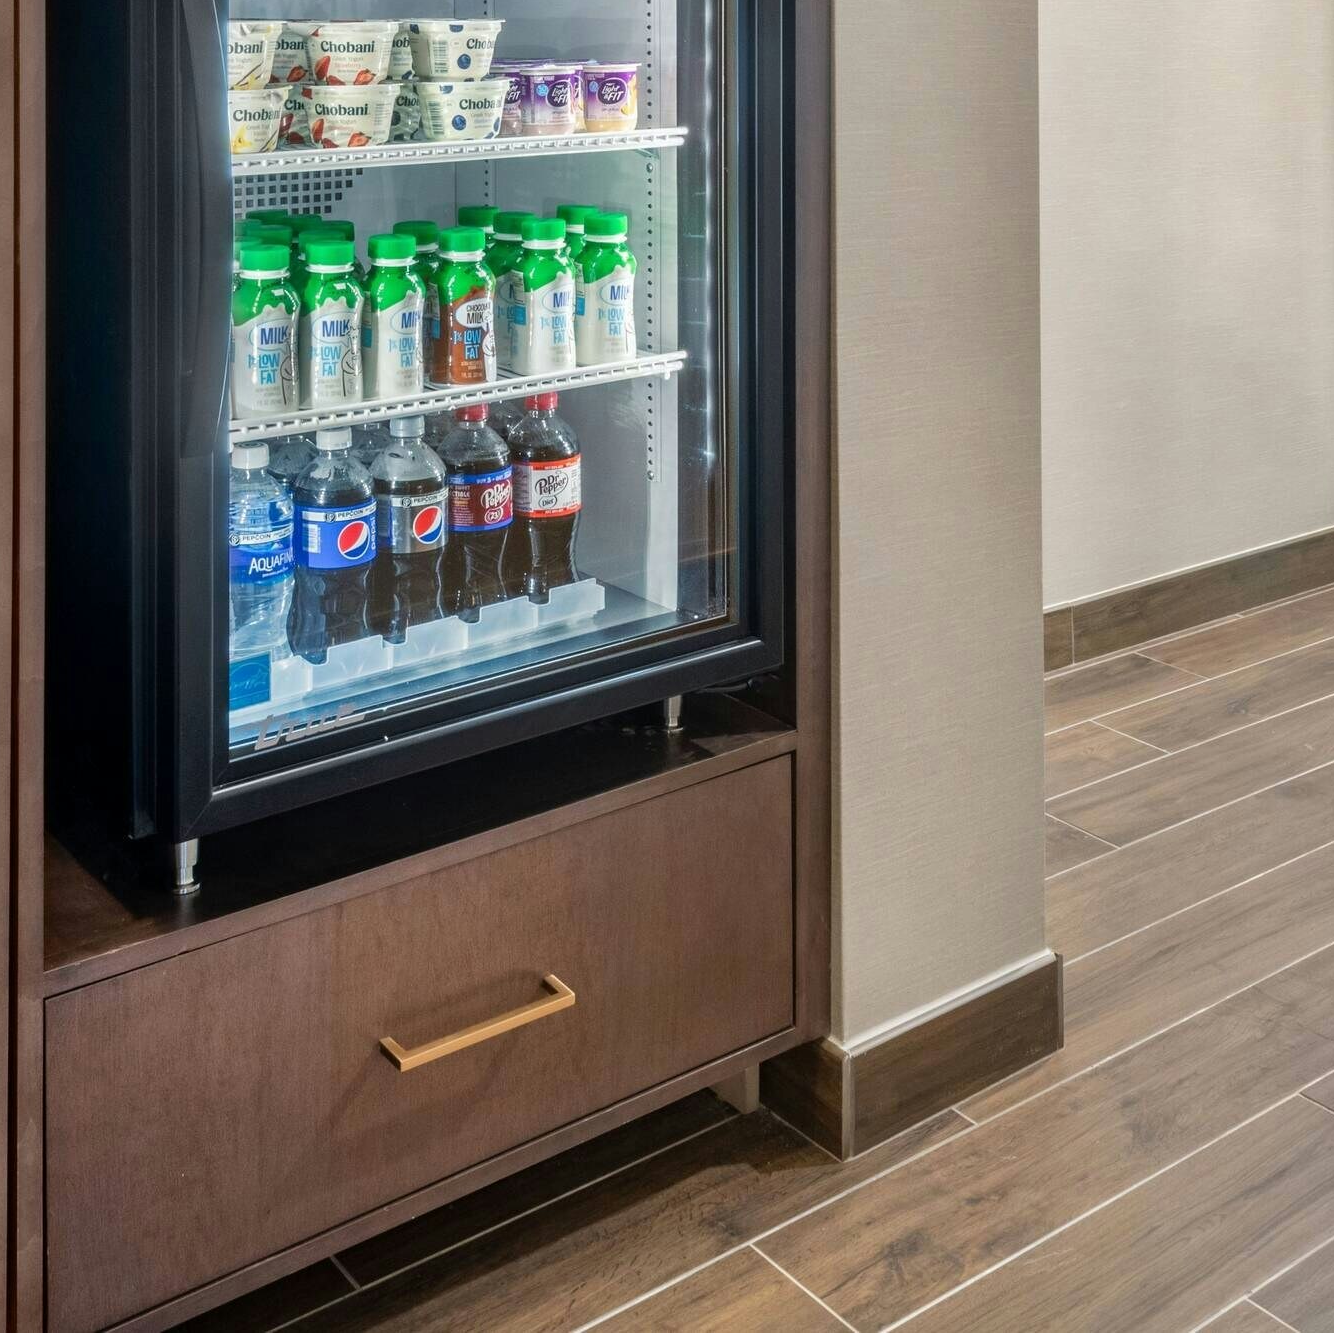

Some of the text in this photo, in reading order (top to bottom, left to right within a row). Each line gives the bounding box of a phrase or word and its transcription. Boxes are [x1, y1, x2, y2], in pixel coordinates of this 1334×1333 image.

[321, 40, 375, 53] Chobani
[602, 85, 619, 93] Light
[315, 104, 368, 116] Chobani
[467, 312, 485, 324] MILK
[260, 325, 289, 345] MILK
[322, 319, 350, 337] MILK
[608, 323, 622, 336] FAT
[463, 330, 482, 345] LOW
[553, 331, 566, 345] FAT
[321, 346, 341, 361] LOW
[465, 346, 480, 360] FAT
[400, 354, 414, 368] FAT
[322, 363, 339, 377] FAT
[260, 371, 278, 385] FAT
[536, 477, 567, 495] Pepper
[548, 475, 560, 487] Dr
[413, 496, 437, 504] PEPCOIN
[483, 489, 511, 508] Pepper
[542, 498, 555, 507] Diet
[337, 510, 364, 519] PEPCOIN
